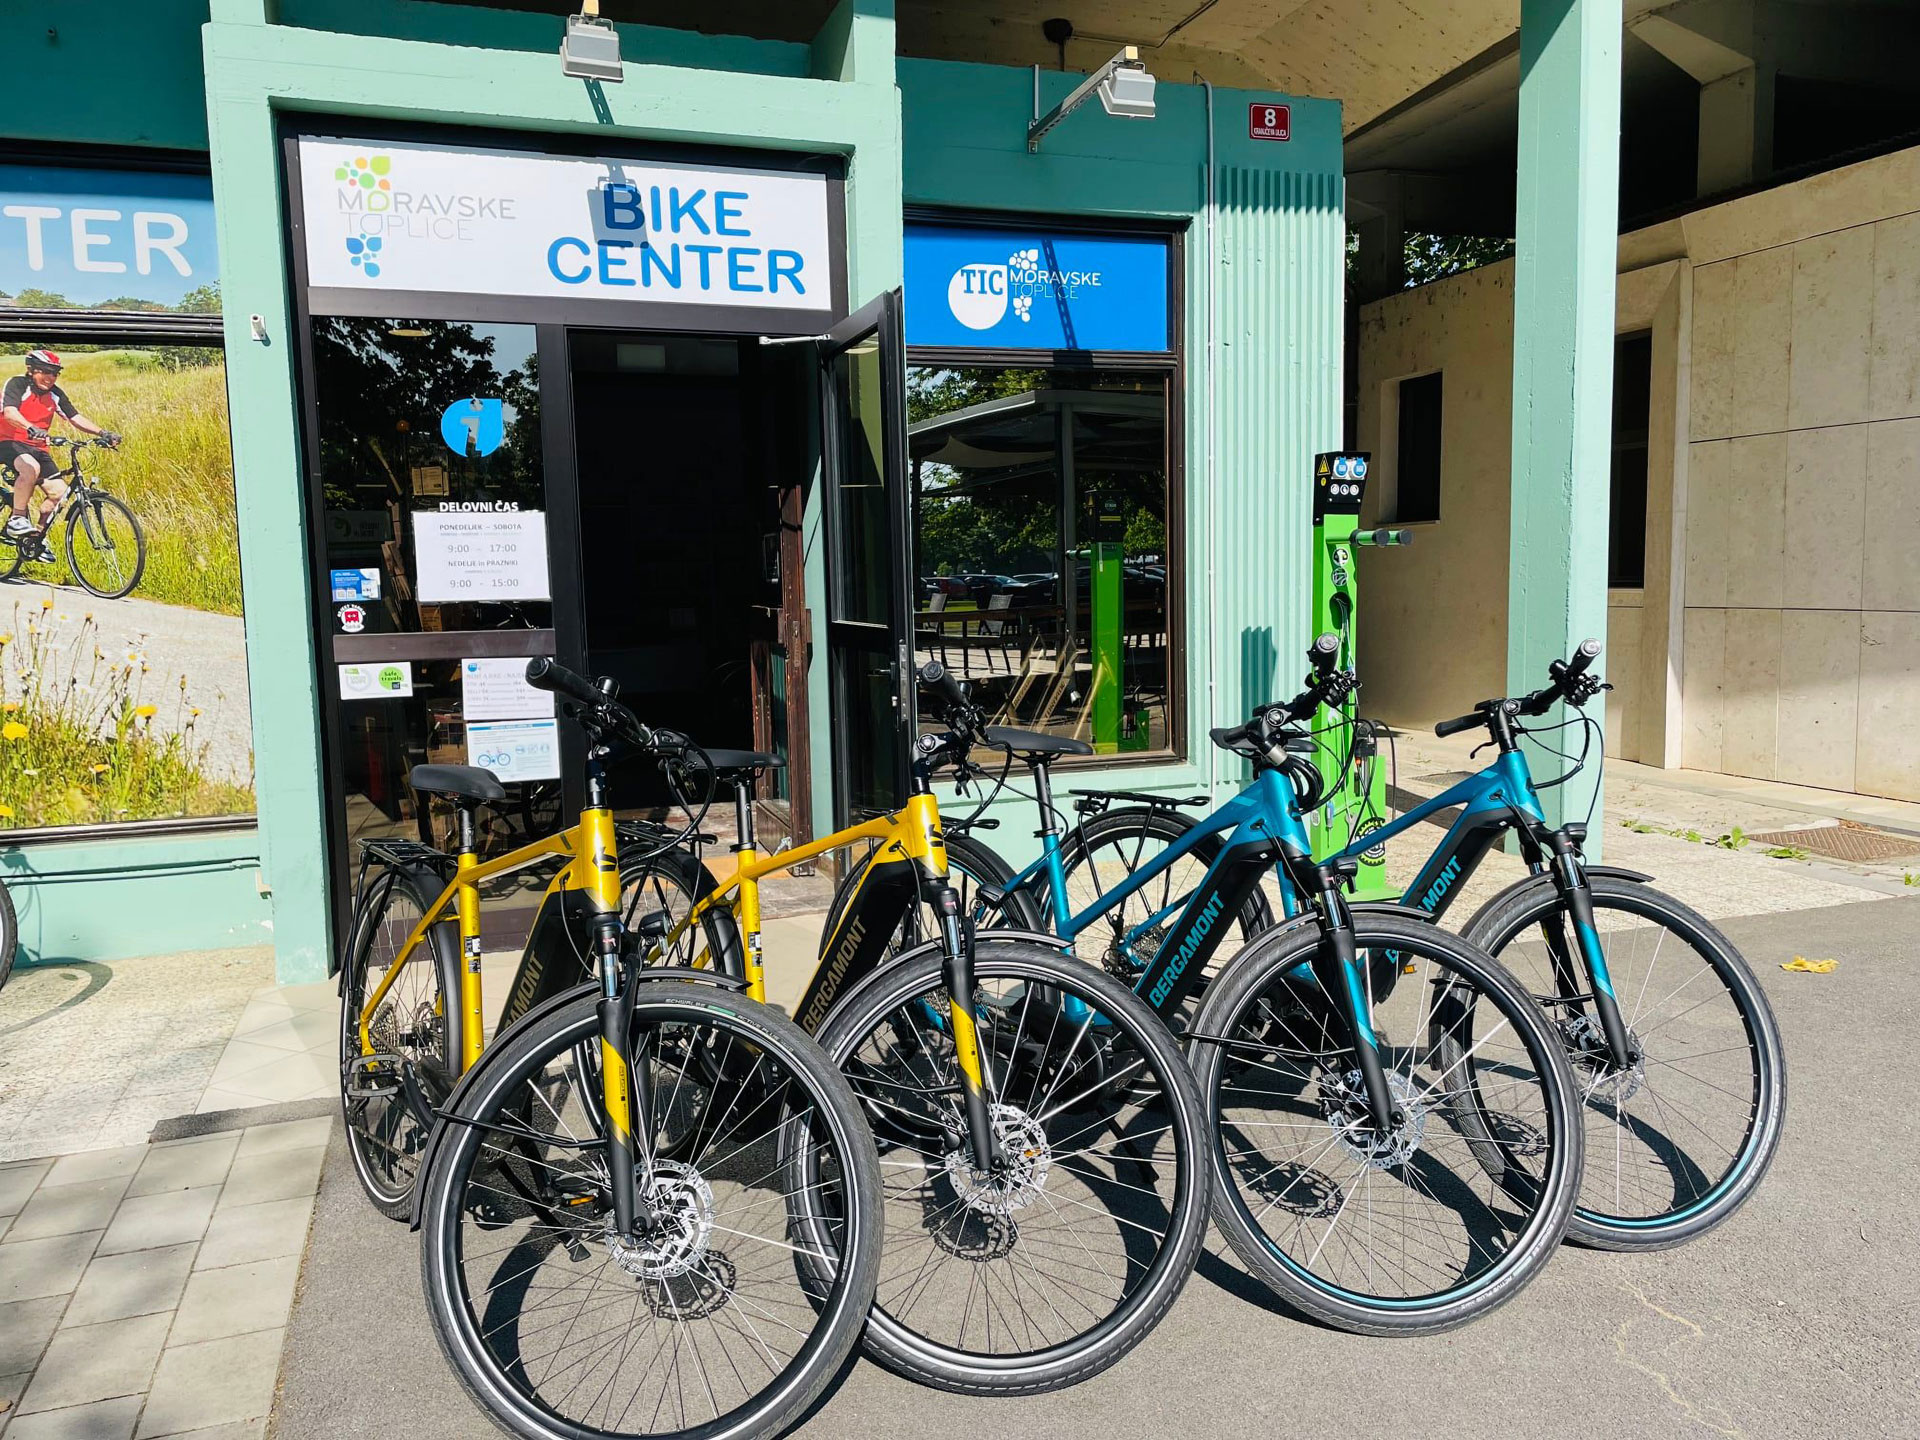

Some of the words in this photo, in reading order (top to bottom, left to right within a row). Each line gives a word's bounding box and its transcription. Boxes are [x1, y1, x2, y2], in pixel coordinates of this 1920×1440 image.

[1264, 108, 1277, 127] 8
[337, 187, 517, 220] MORAVSKE
[603, 182, 752, 237] BIKE
[339, 211, 474, 241] TOPLICE
[547, 236, 806, 295] CENTER
[960, 269, 1004, 296] TIC
[1010, 268, 1102, 287] MORAVSKE
[1011, 282, 1079, 300] TOPLICE
[440, 501, 492, 513] DELOVNI
[494, 500, 519, 513] ČAS
[440, 523, 483, 531] PONEDELJEK
[447, 544, 470, 553] 9:00
[490, 543, 517, 553] 17:00
[486, 559, 518, 567] PRAZNIKI
[449, 579, 472, 588] 9:00
[491, 578, 519, 588] 15:00
[1148, 889, 1225, 1009] BERGAMONT
[801, 914, 867, 1040] BERGAMONT
